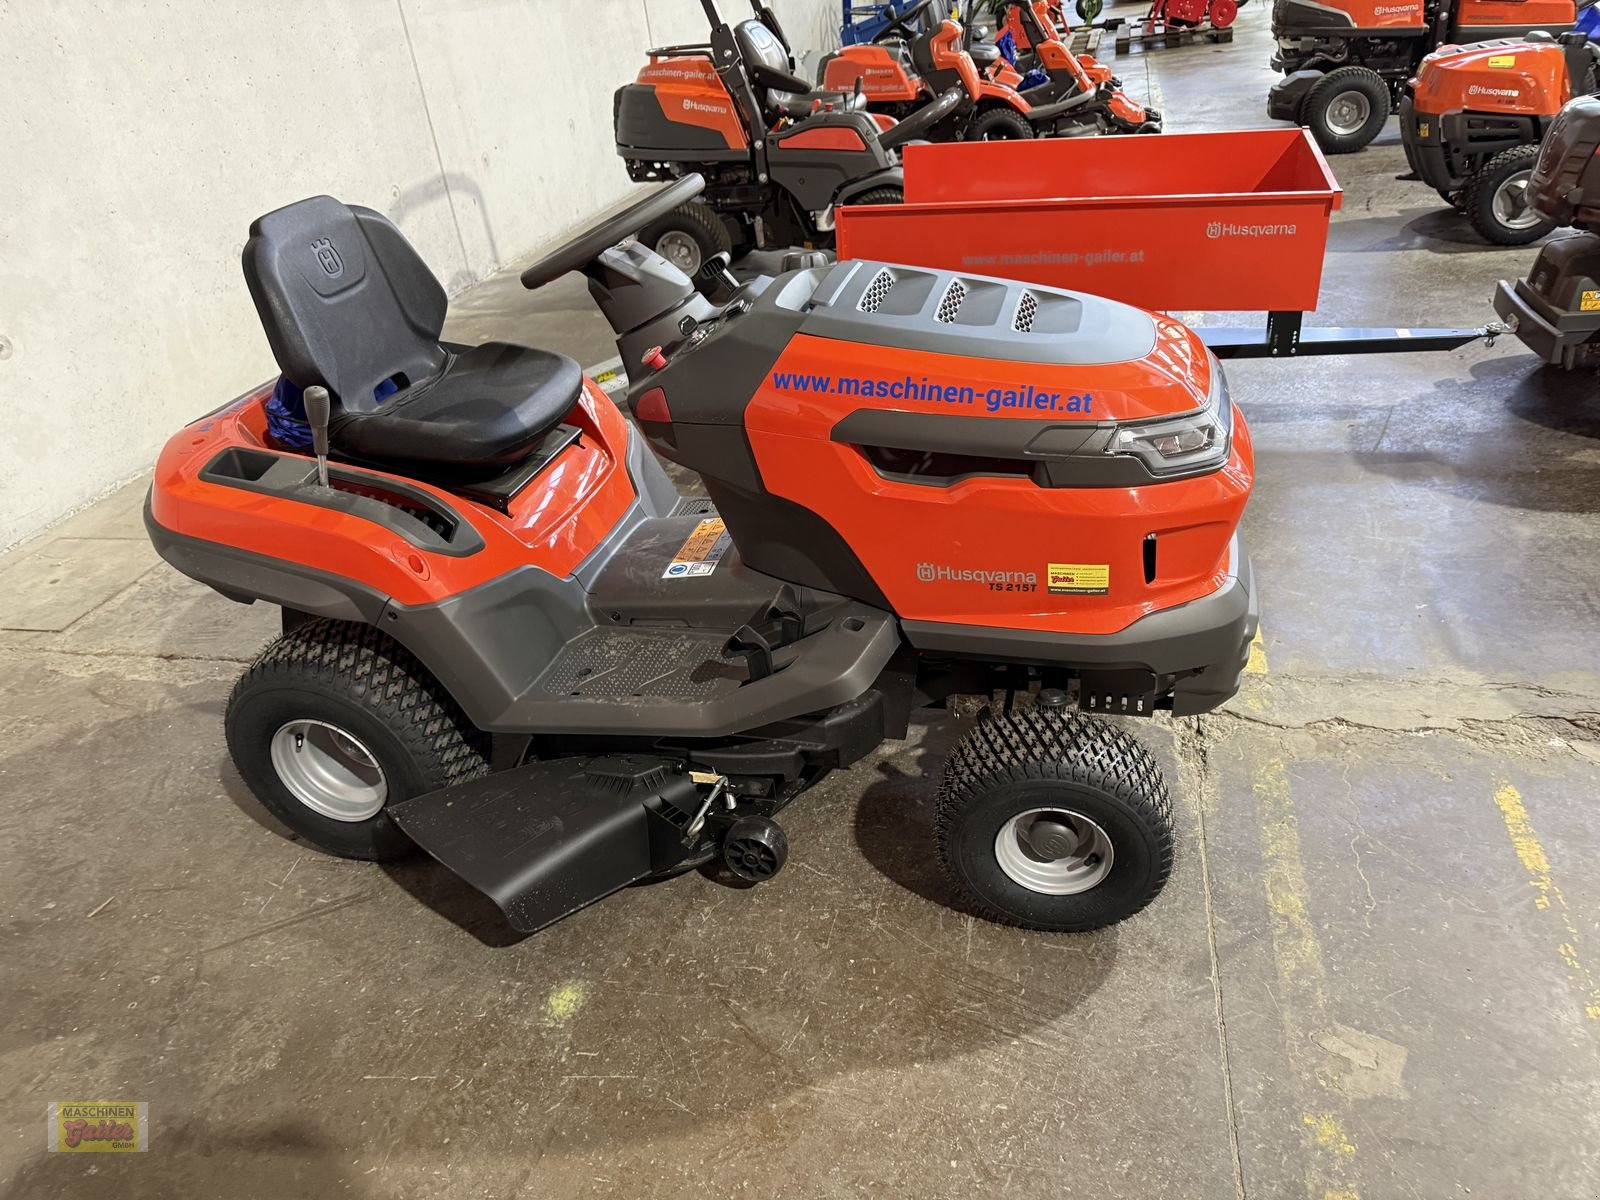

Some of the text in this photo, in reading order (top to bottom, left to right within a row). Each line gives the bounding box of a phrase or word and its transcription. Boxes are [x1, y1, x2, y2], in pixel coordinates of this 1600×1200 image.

[1382, 4, 1419, 14] Husqvarna
[1477, 86, 1520, 97] Husqvarna
[690, 101, 727, 114] Husqvarna
[1222, 223, 1297, 237] Husqvarna
[962, 249, 1145, 266] www.maschinen-gailer.at
[773, 372, 1093, 413] www.maschinen-gailer.at
[938, 565, 1037, 584] Husqvarna
[1006, 584, 1038, 592] 215T
